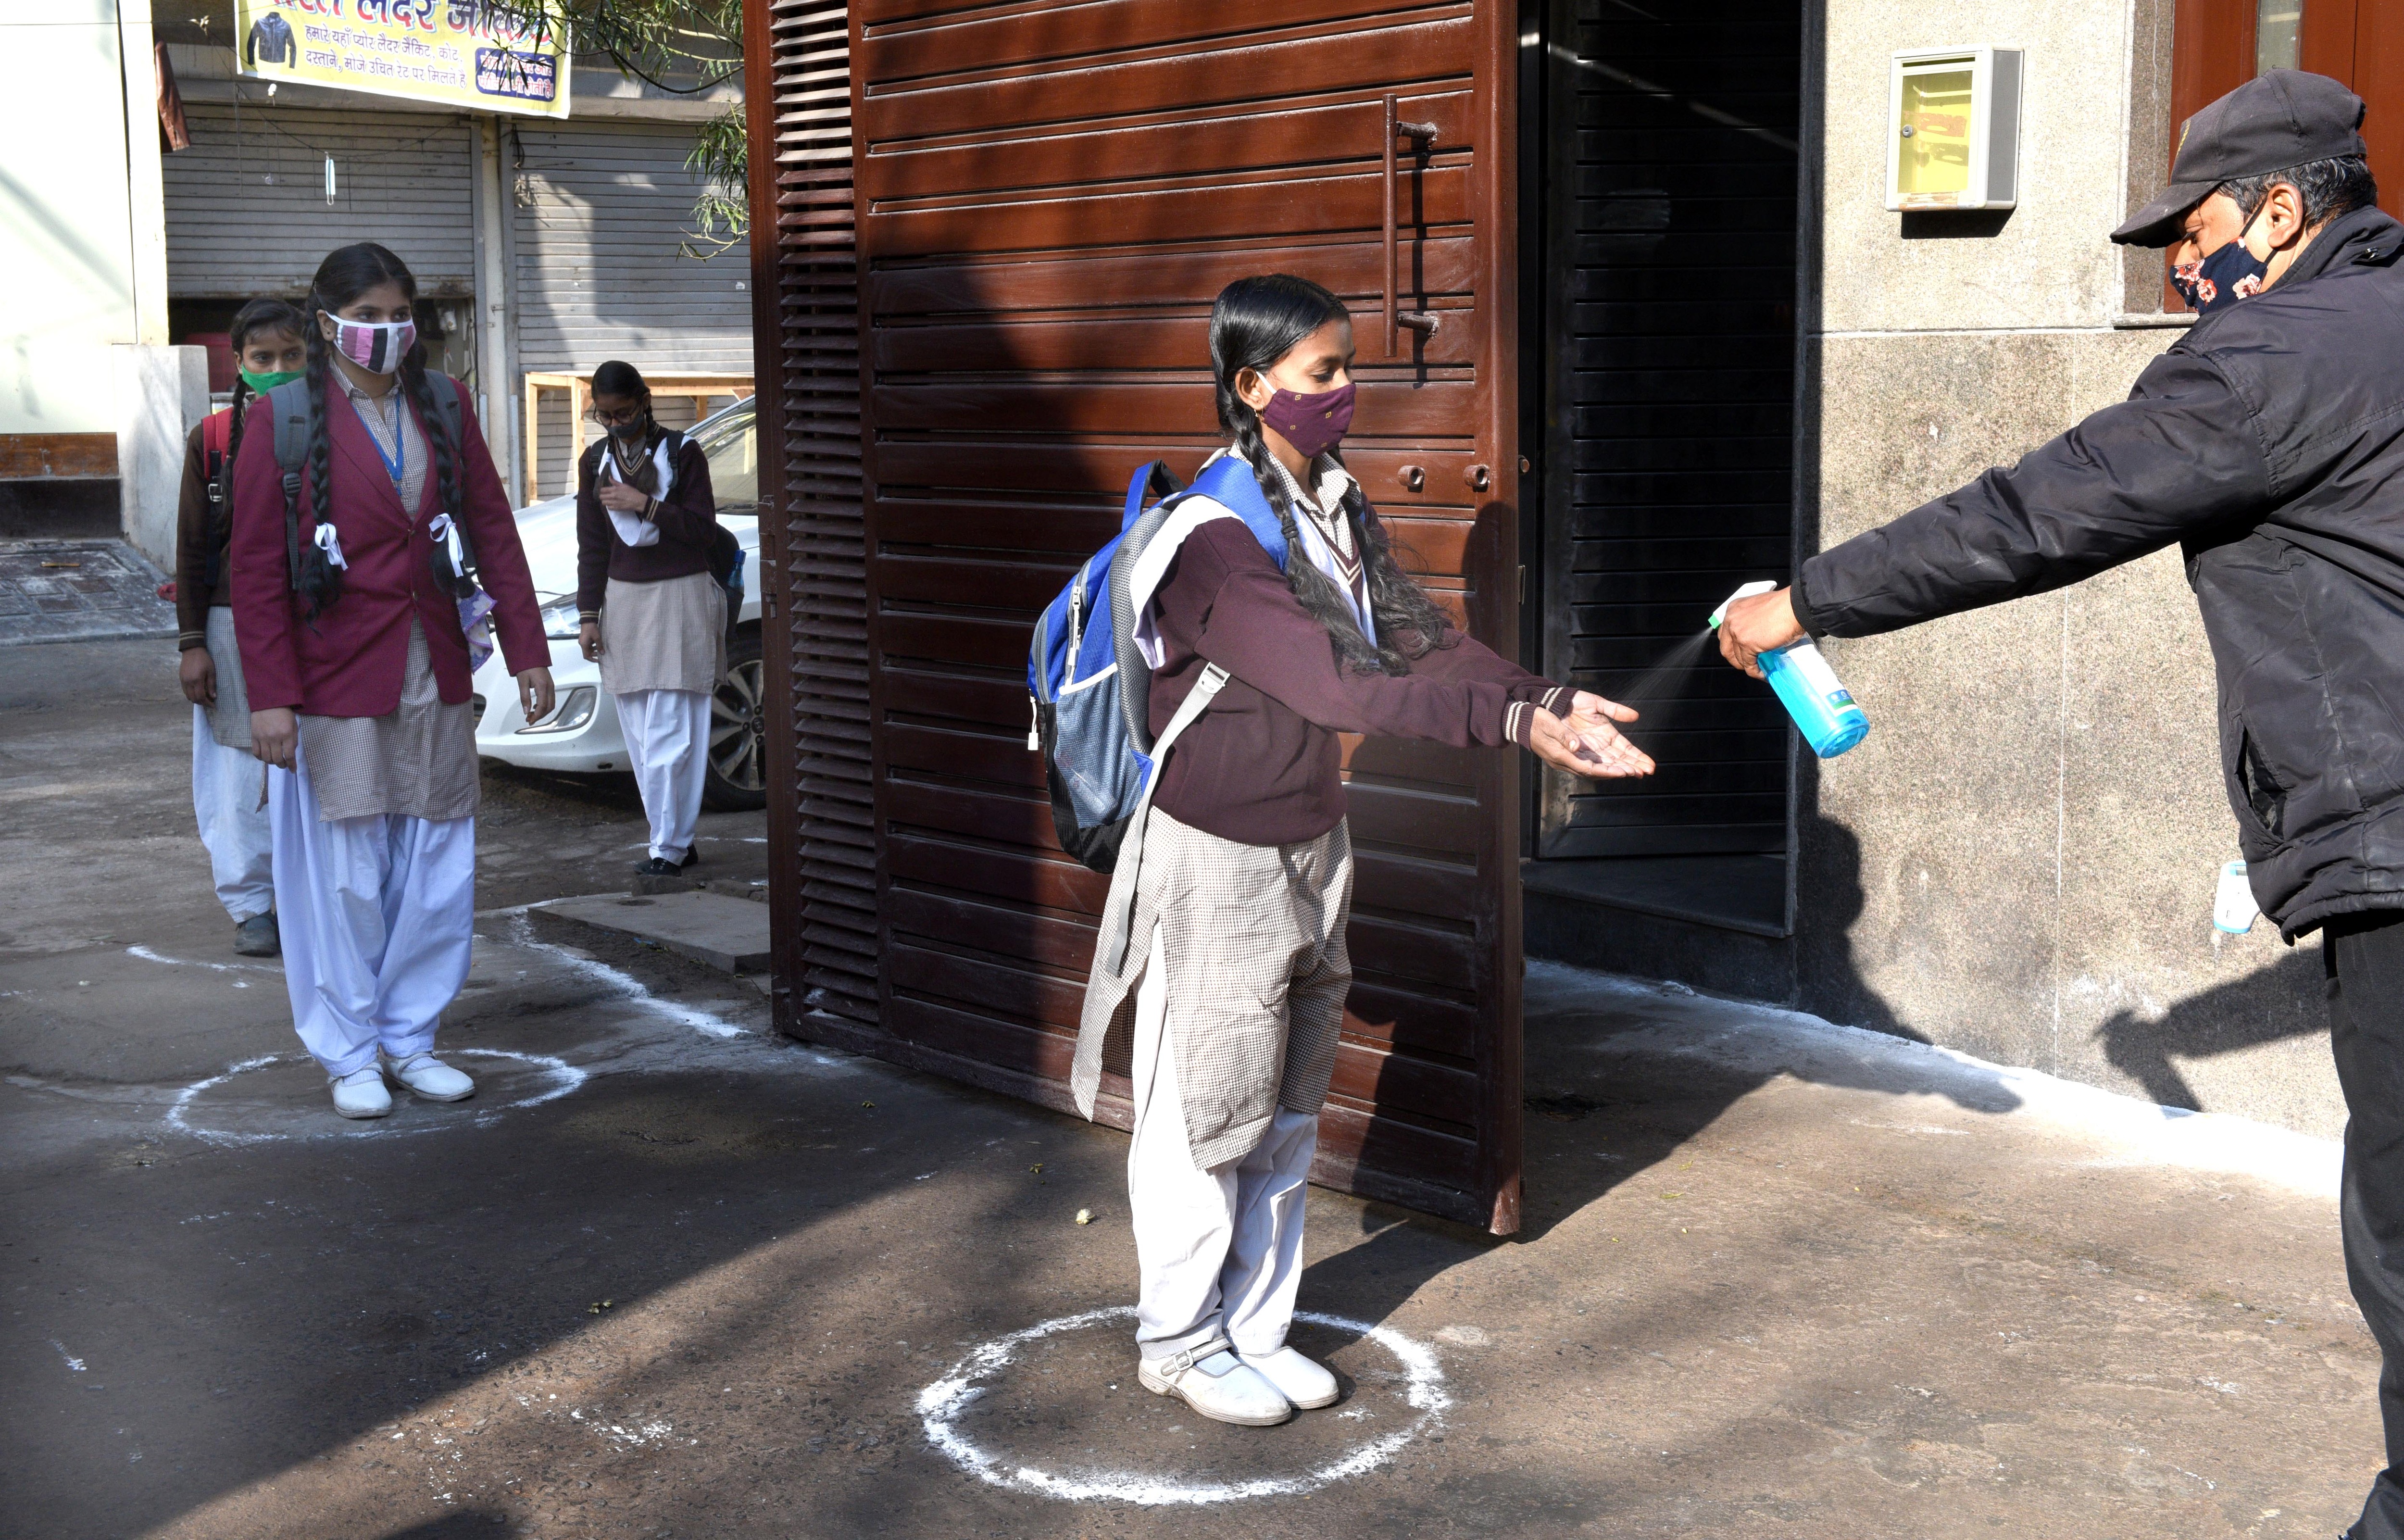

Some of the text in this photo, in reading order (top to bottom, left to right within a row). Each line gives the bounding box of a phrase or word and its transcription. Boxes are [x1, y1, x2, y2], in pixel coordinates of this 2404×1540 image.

[305, 23, 330, 42] हमारे
[332, 27, 351, 49] यहाँ
[353, 30, 374, 49] प्योर
[377, 33, 398, 53] लैदर
[344, 53, 365, 72] मोजे
[369, 57, 393, 76] उचित
[397, 60, 409, 78] रेट
[413, 68, 425, 80] पर
[428, 65, 456, 85] मिलते
